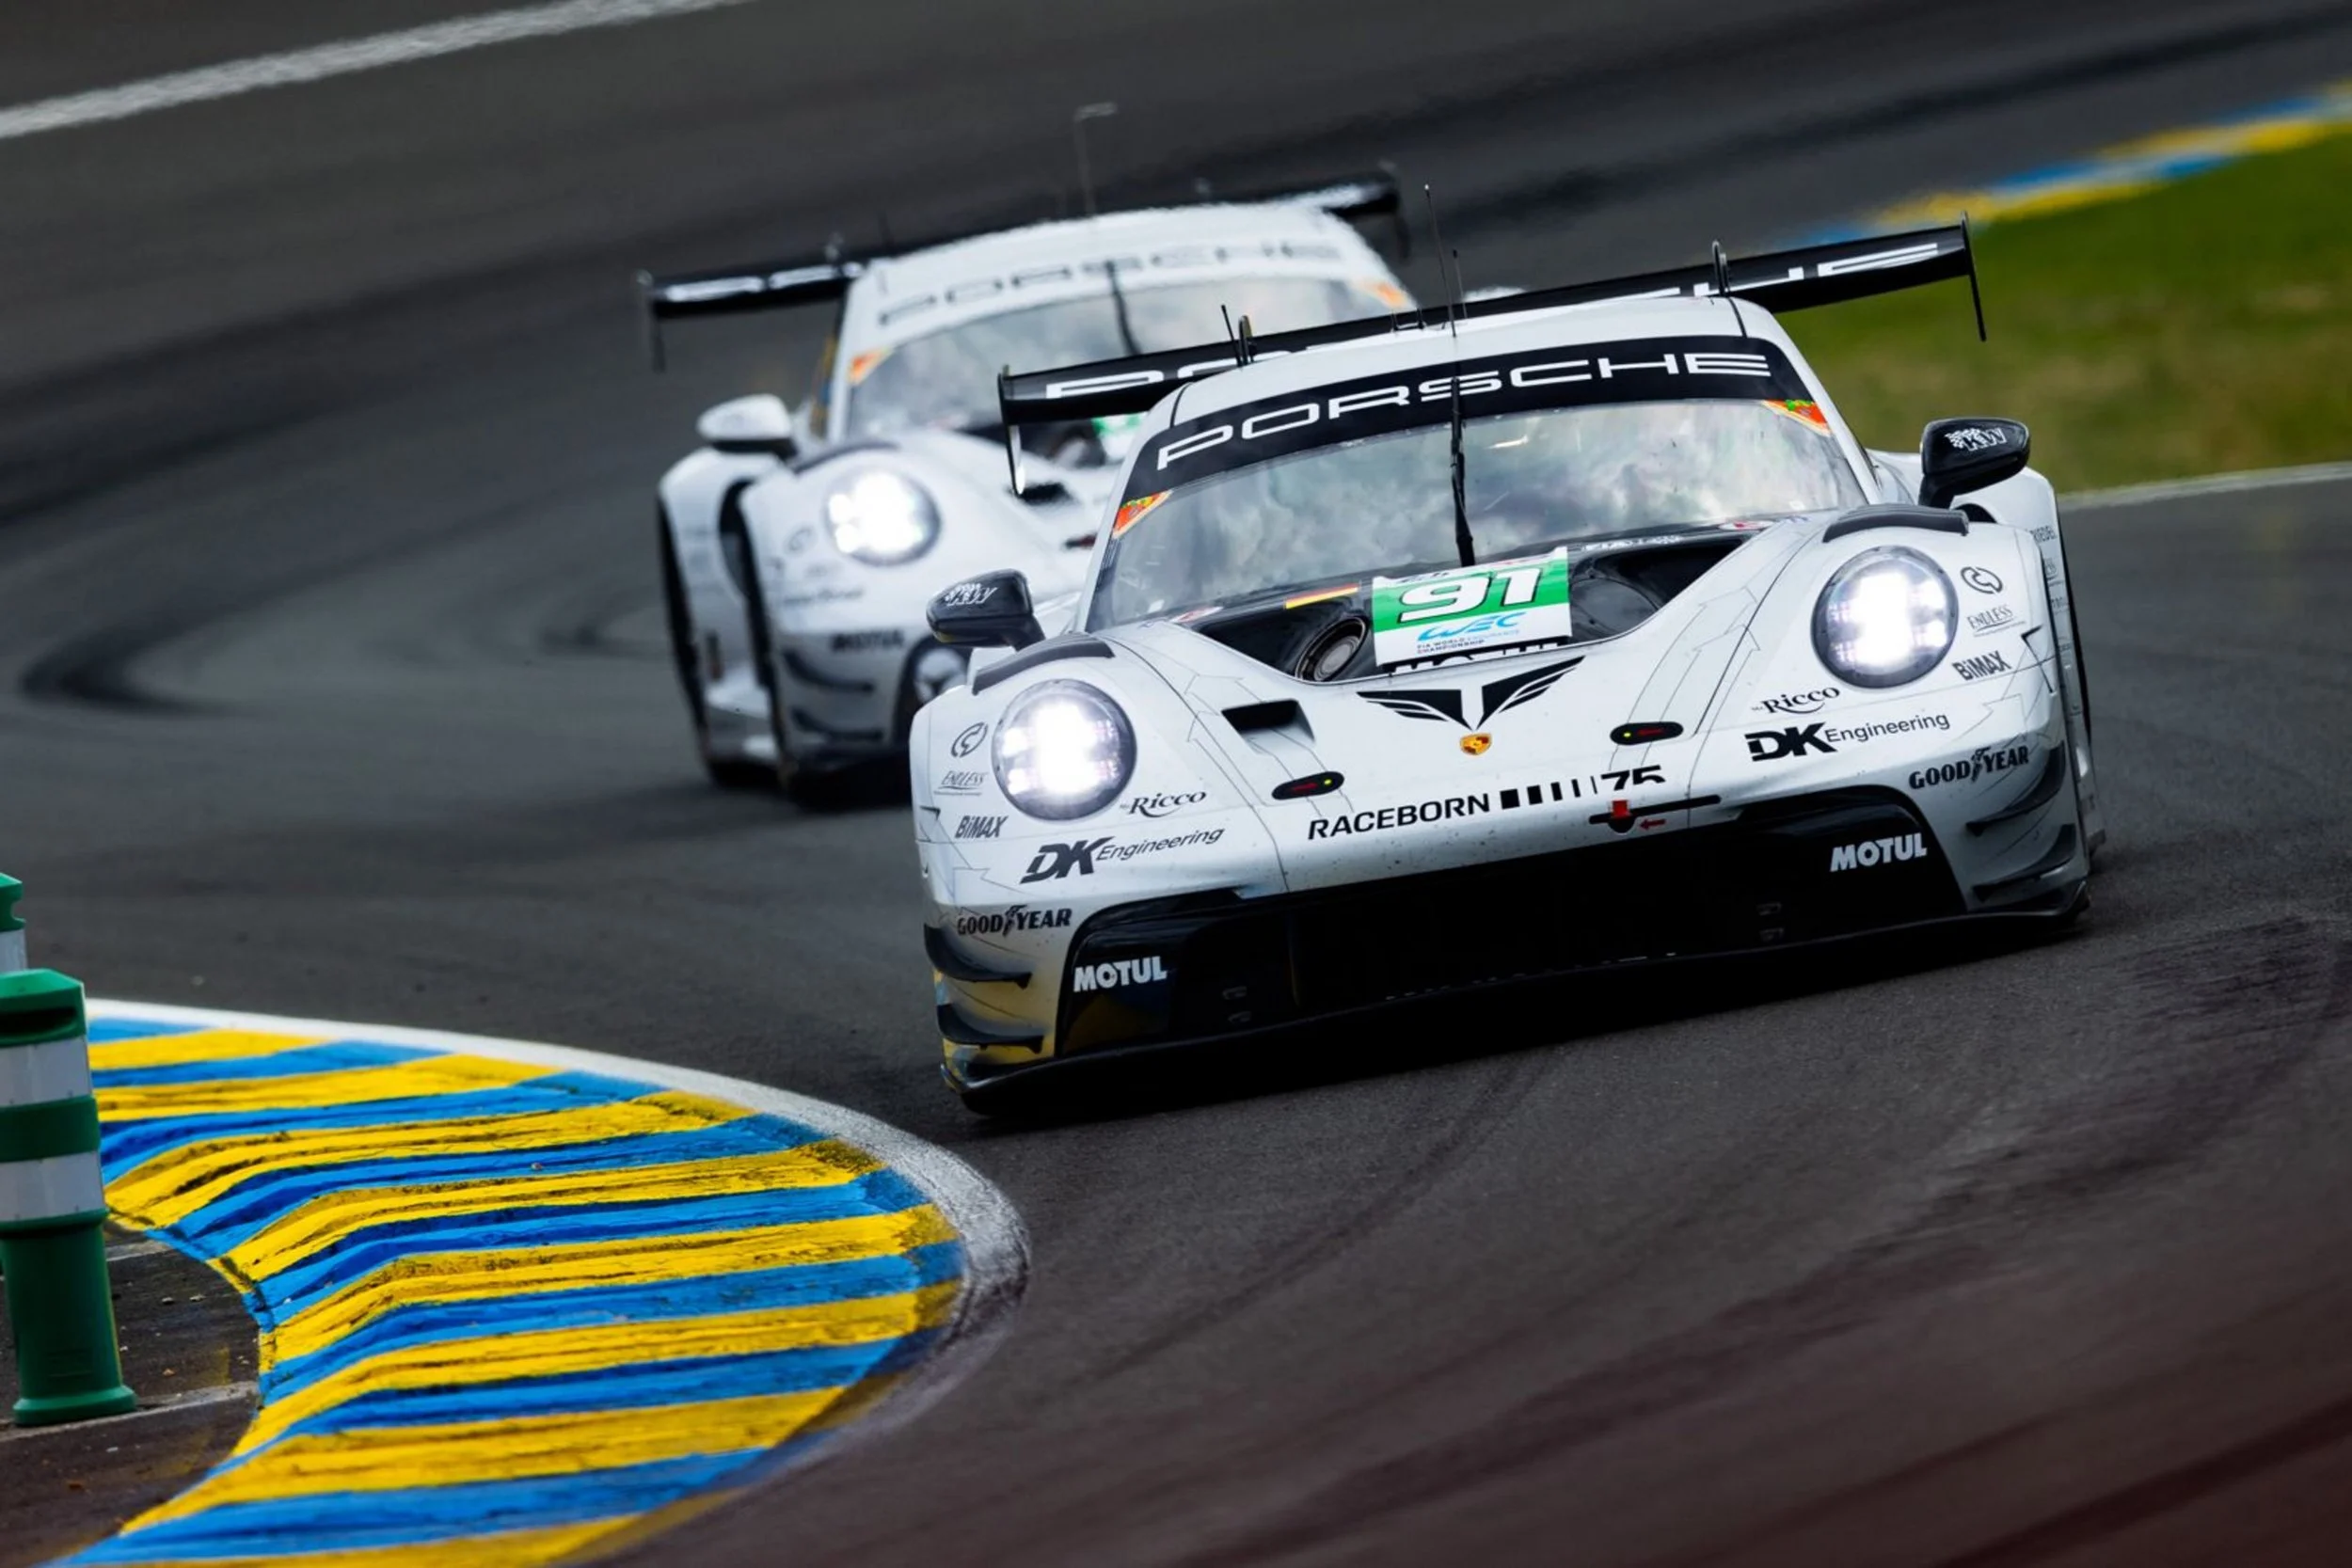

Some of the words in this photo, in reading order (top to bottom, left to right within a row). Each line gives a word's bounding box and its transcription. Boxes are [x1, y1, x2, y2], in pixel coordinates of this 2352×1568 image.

[878, 241, 1343, 325] PORSCHE
[1156, 353, 1772, 470] PORSCHE
[1397, 567, 1544, 624] 91
[1966, 605, 2013, 629] ENDLESS
[1417, 611, 1527, 641] WEC
[1744, 721, 1838, 762] DK
[1824, 714, 1950, 742] Engineering
[1600, 765, 1666, 791] 75
[1308, 793, 1490, 840] RACEBORN
[1019, 835, 1116, 884] DK
[1095, 828, 1226, 861] Engineering
[1830, 832, 1928, 873] MOTUL
[1073, 956, 1168, 992] MOTUL
